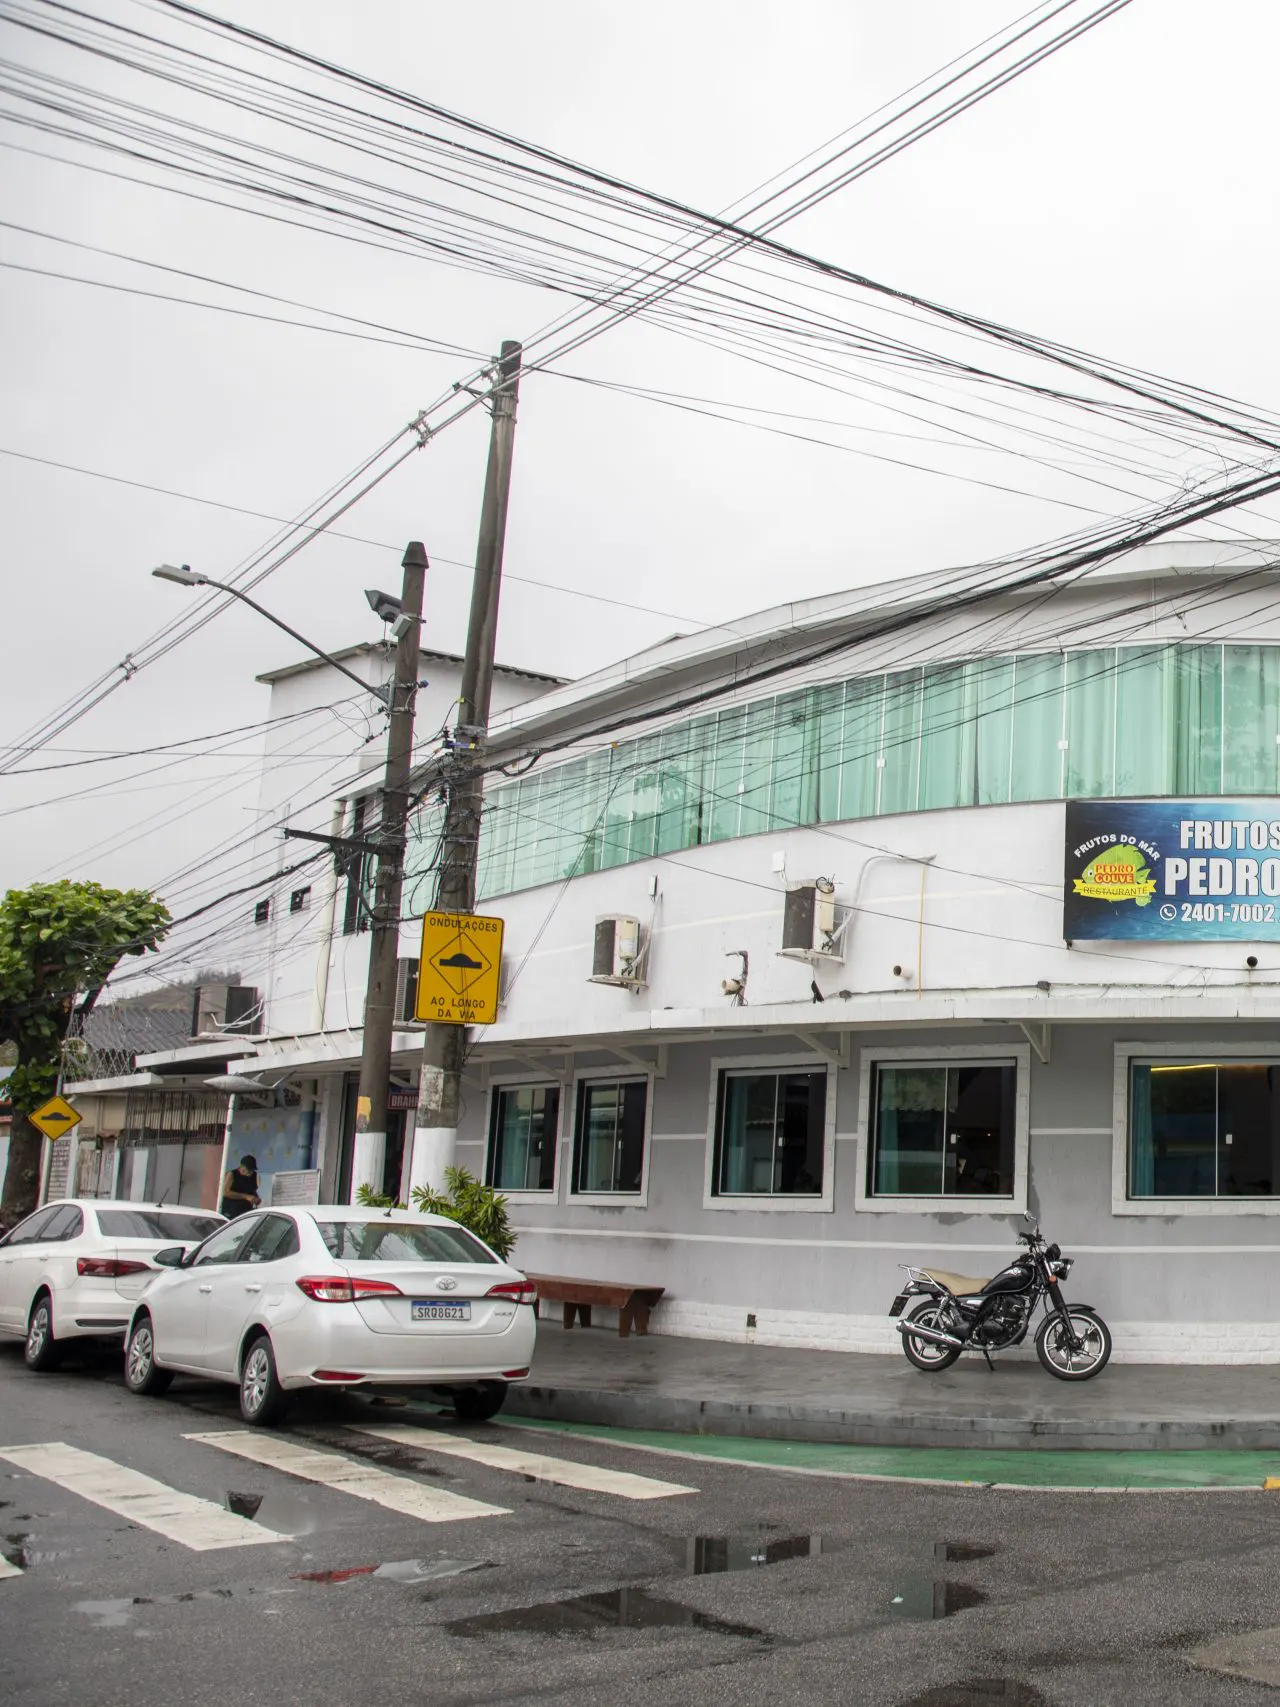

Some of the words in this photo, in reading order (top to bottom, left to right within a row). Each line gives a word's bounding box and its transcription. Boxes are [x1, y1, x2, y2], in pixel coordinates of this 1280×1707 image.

[1073, 834, 1117, 858] FRUTOS
[1120, 834, 1137, 845] DO
[1138, 840, 1161, 861] MAR
[1095, 864, 1134, 873] PEDRO
[1094, 873, 1135, 884] COUVE
[1083, 886, 1148, 896] RESTAURANTE
[1181, 903, 1276, 923] 2401-7002
[429, 917, 498, 933] ONDULAÇÕES
[430, 997, 445, 1006] AO
[451, 998, 486, 1009] LONGO
[437, 1009, 452, 1018] DA
[460, 1011, 476, 1019] VIA
[391, 1095, 419, 1107] BRAH
[417, 1307, 464, 1319] SRQ8G21
